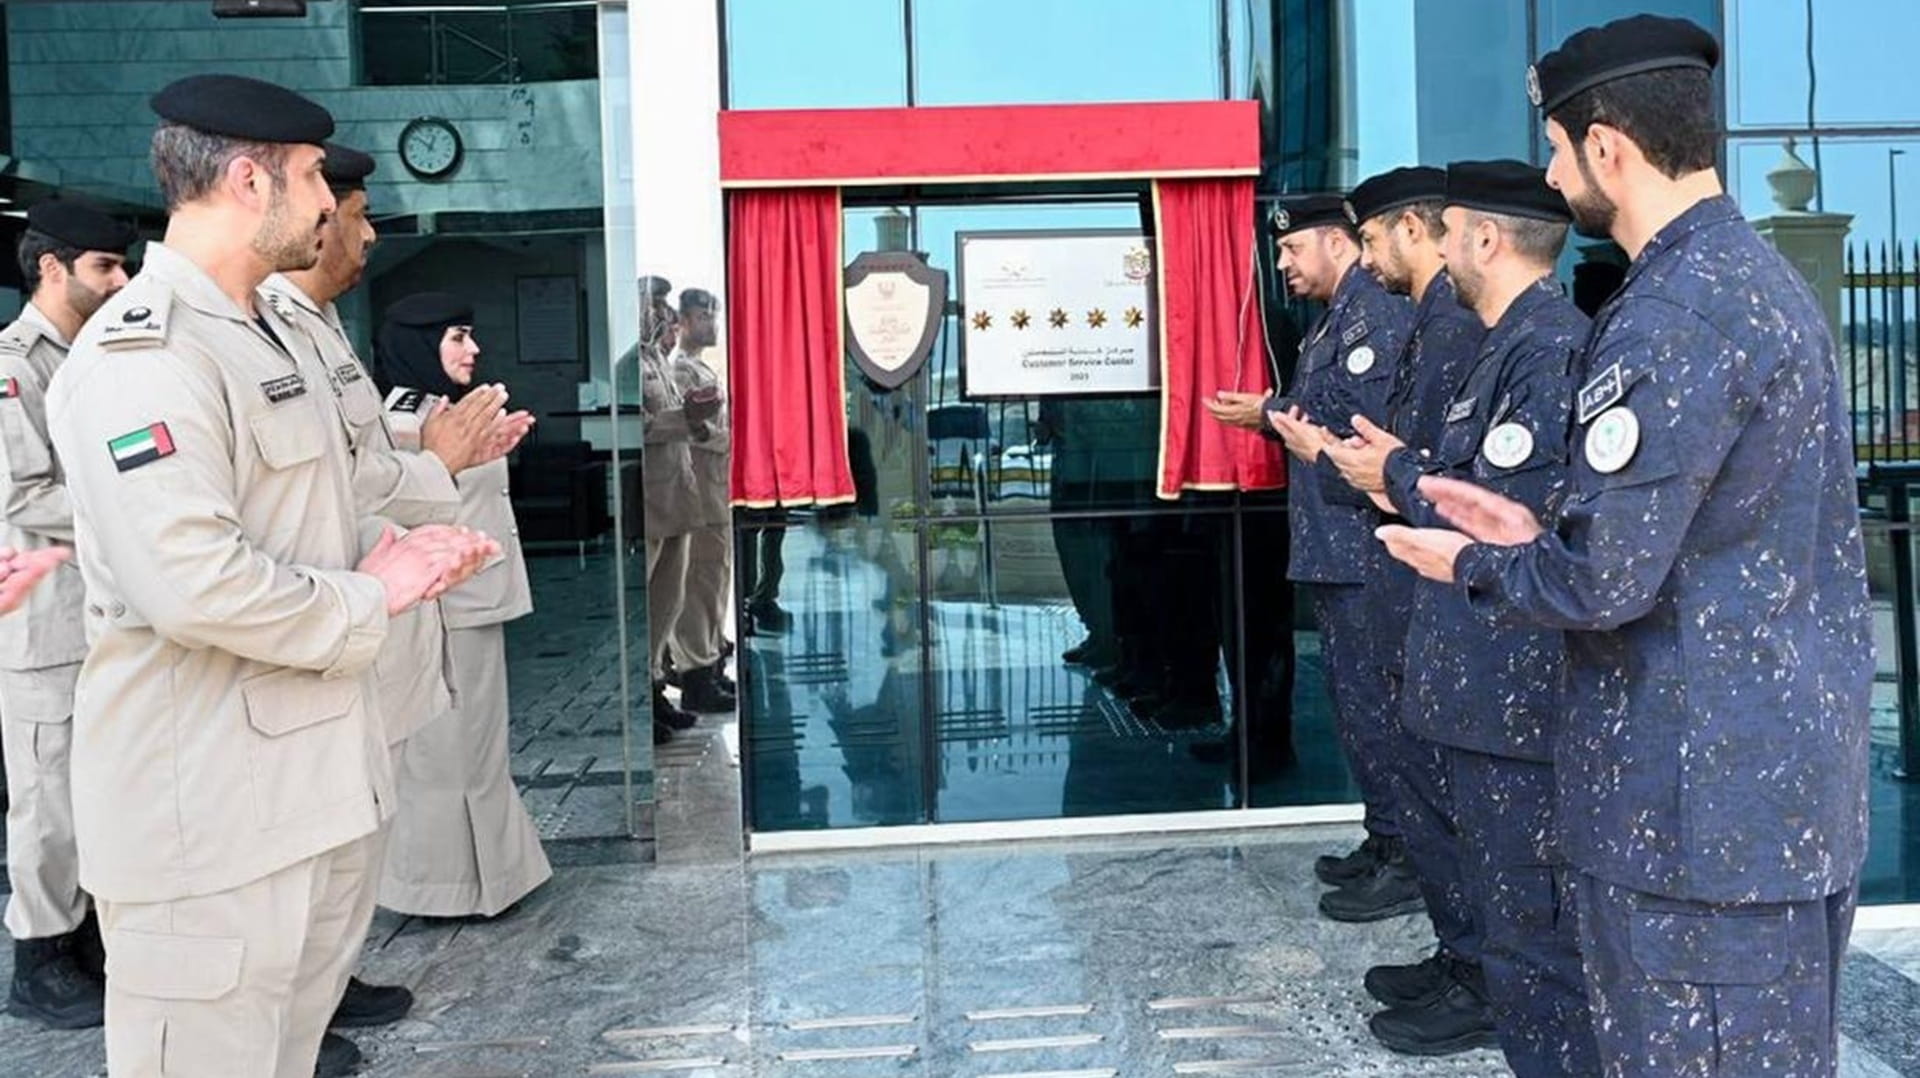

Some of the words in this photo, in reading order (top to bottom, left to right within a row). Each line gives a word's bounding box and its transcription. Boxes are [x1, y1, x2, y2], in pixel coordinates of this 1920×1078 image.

[1022, 359, 1066, 369] Customer
[1068, 358, 1102, 367] Service
[1583, 379, 1616, 412] AB+
